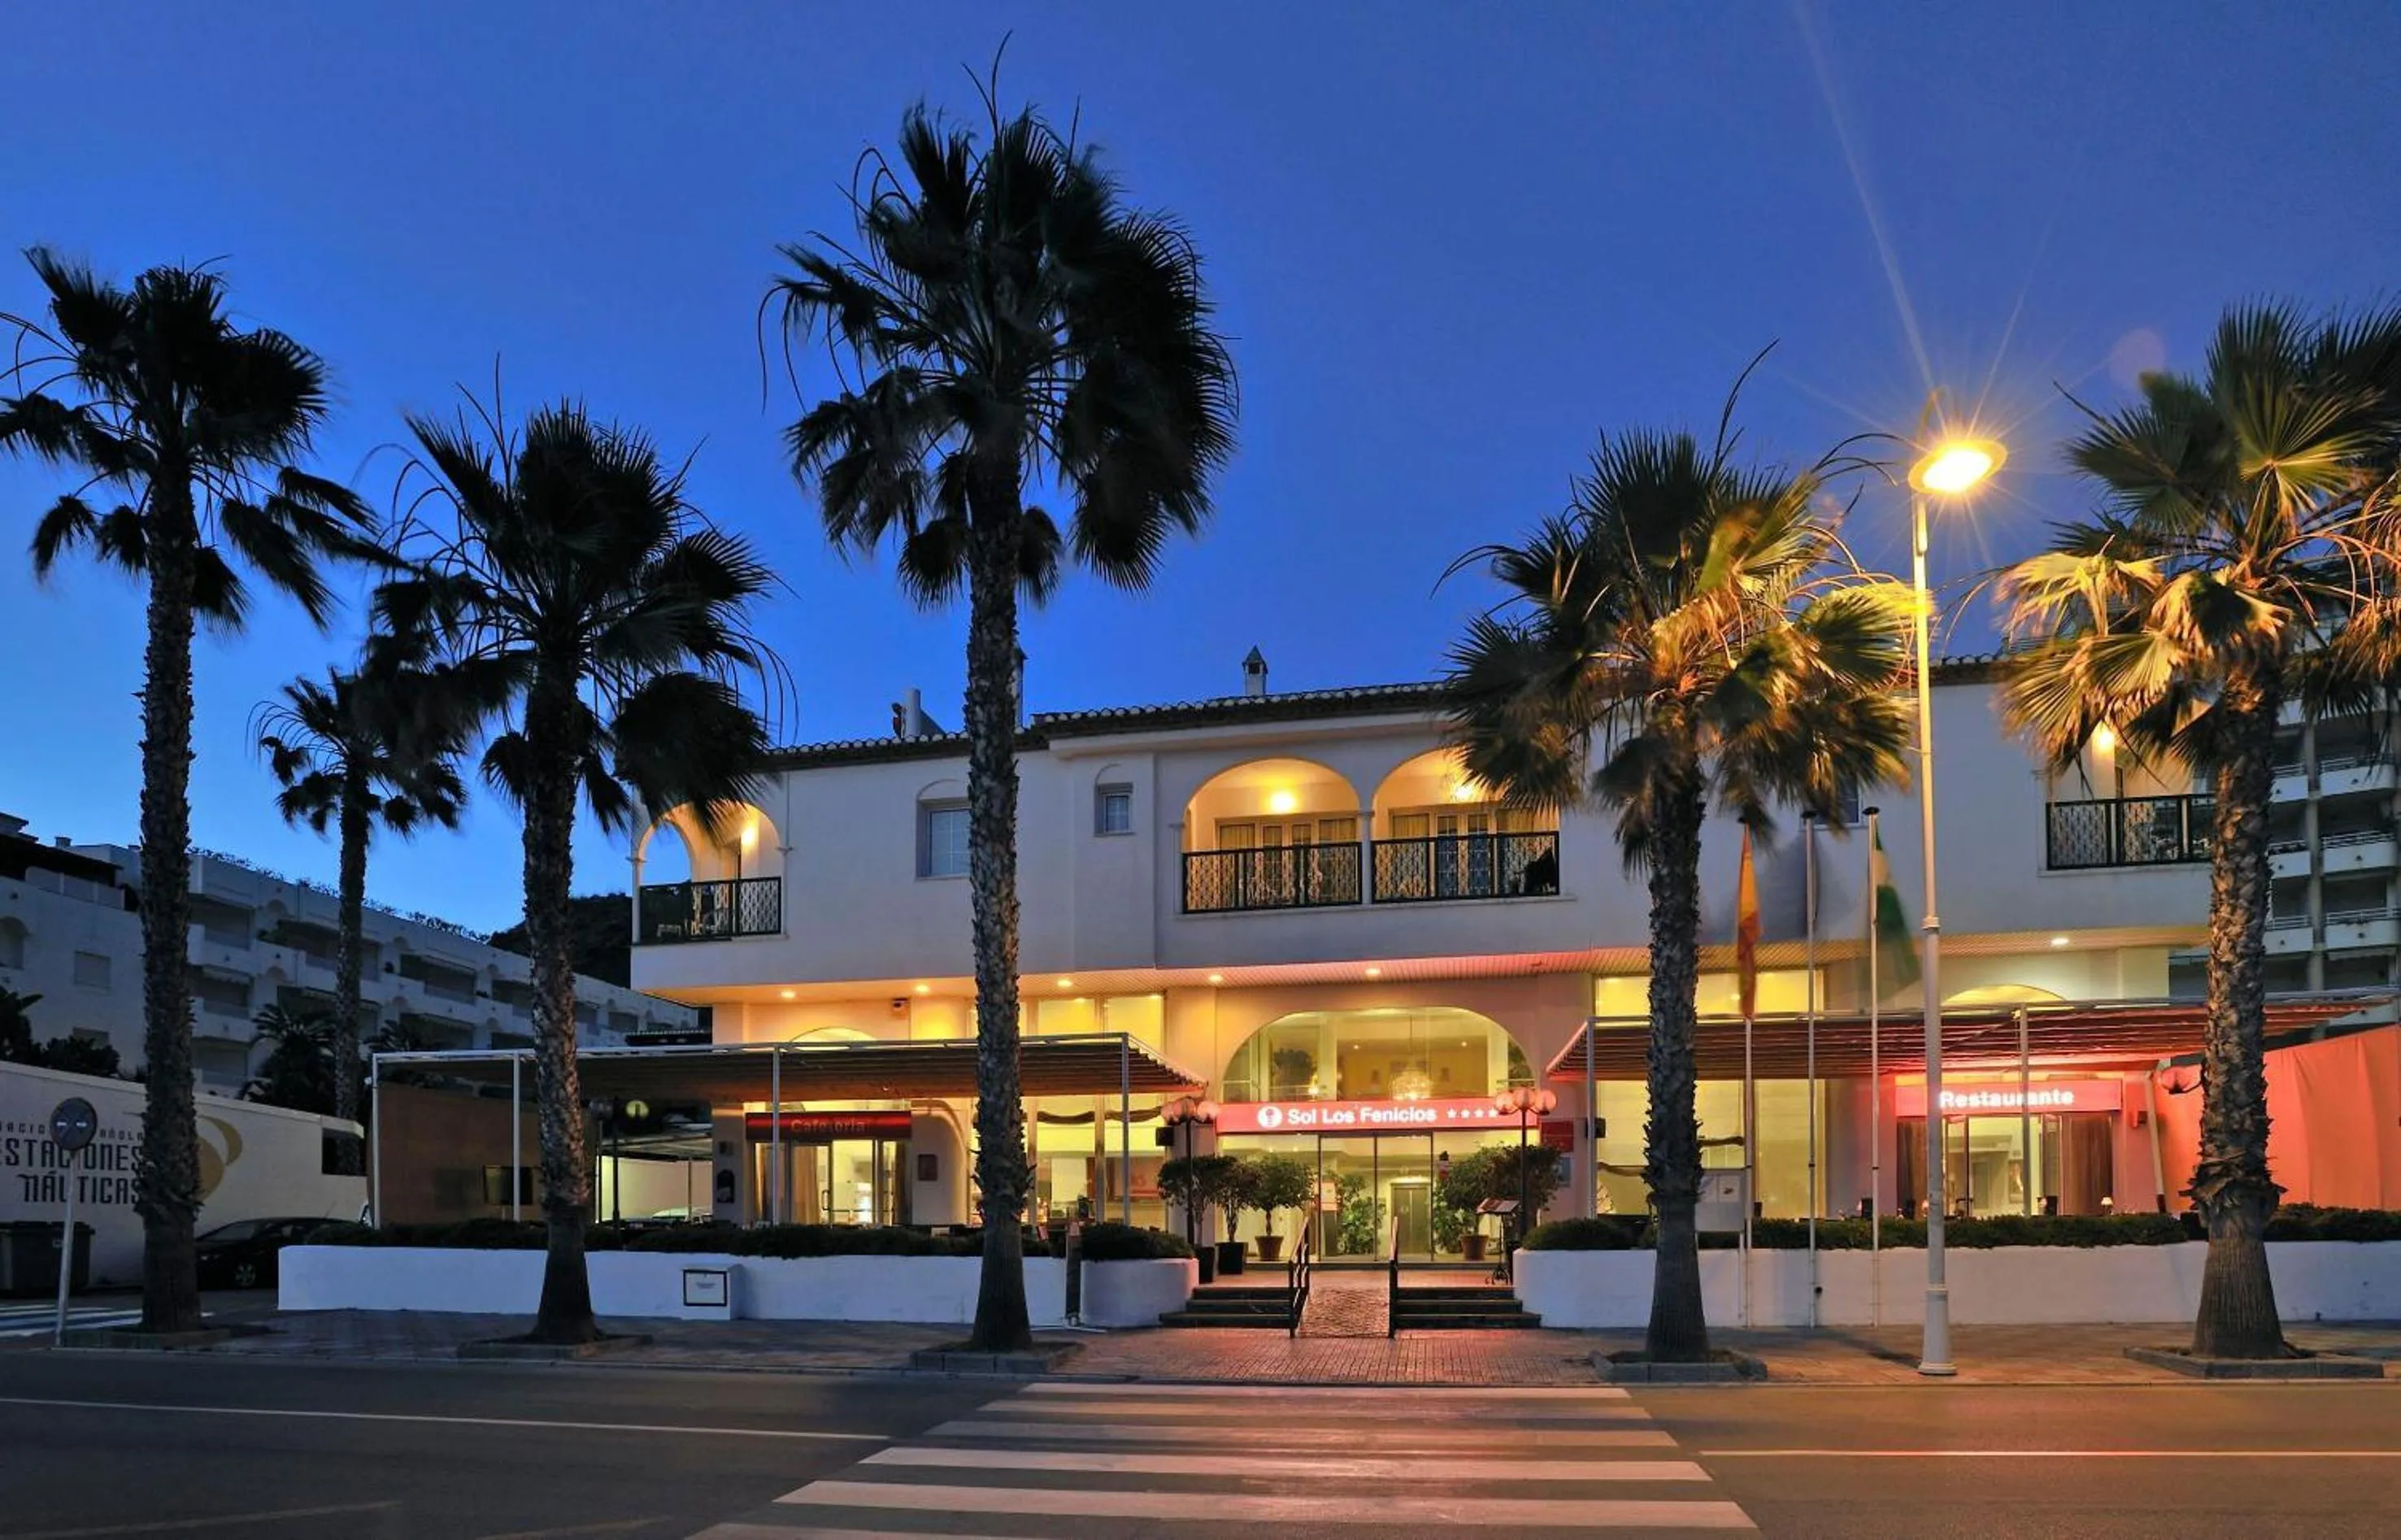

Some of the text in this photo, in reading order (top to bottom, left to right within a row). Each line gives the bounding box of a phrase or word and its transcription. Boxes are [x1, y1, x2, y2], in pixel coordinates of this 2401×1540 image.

[1939, 1089, 2074, 1107] Restaurante
[1288, 1107, 1437, 1125] Sol Los Fenicios
[0, 1138, 141, 1172] STACONES
